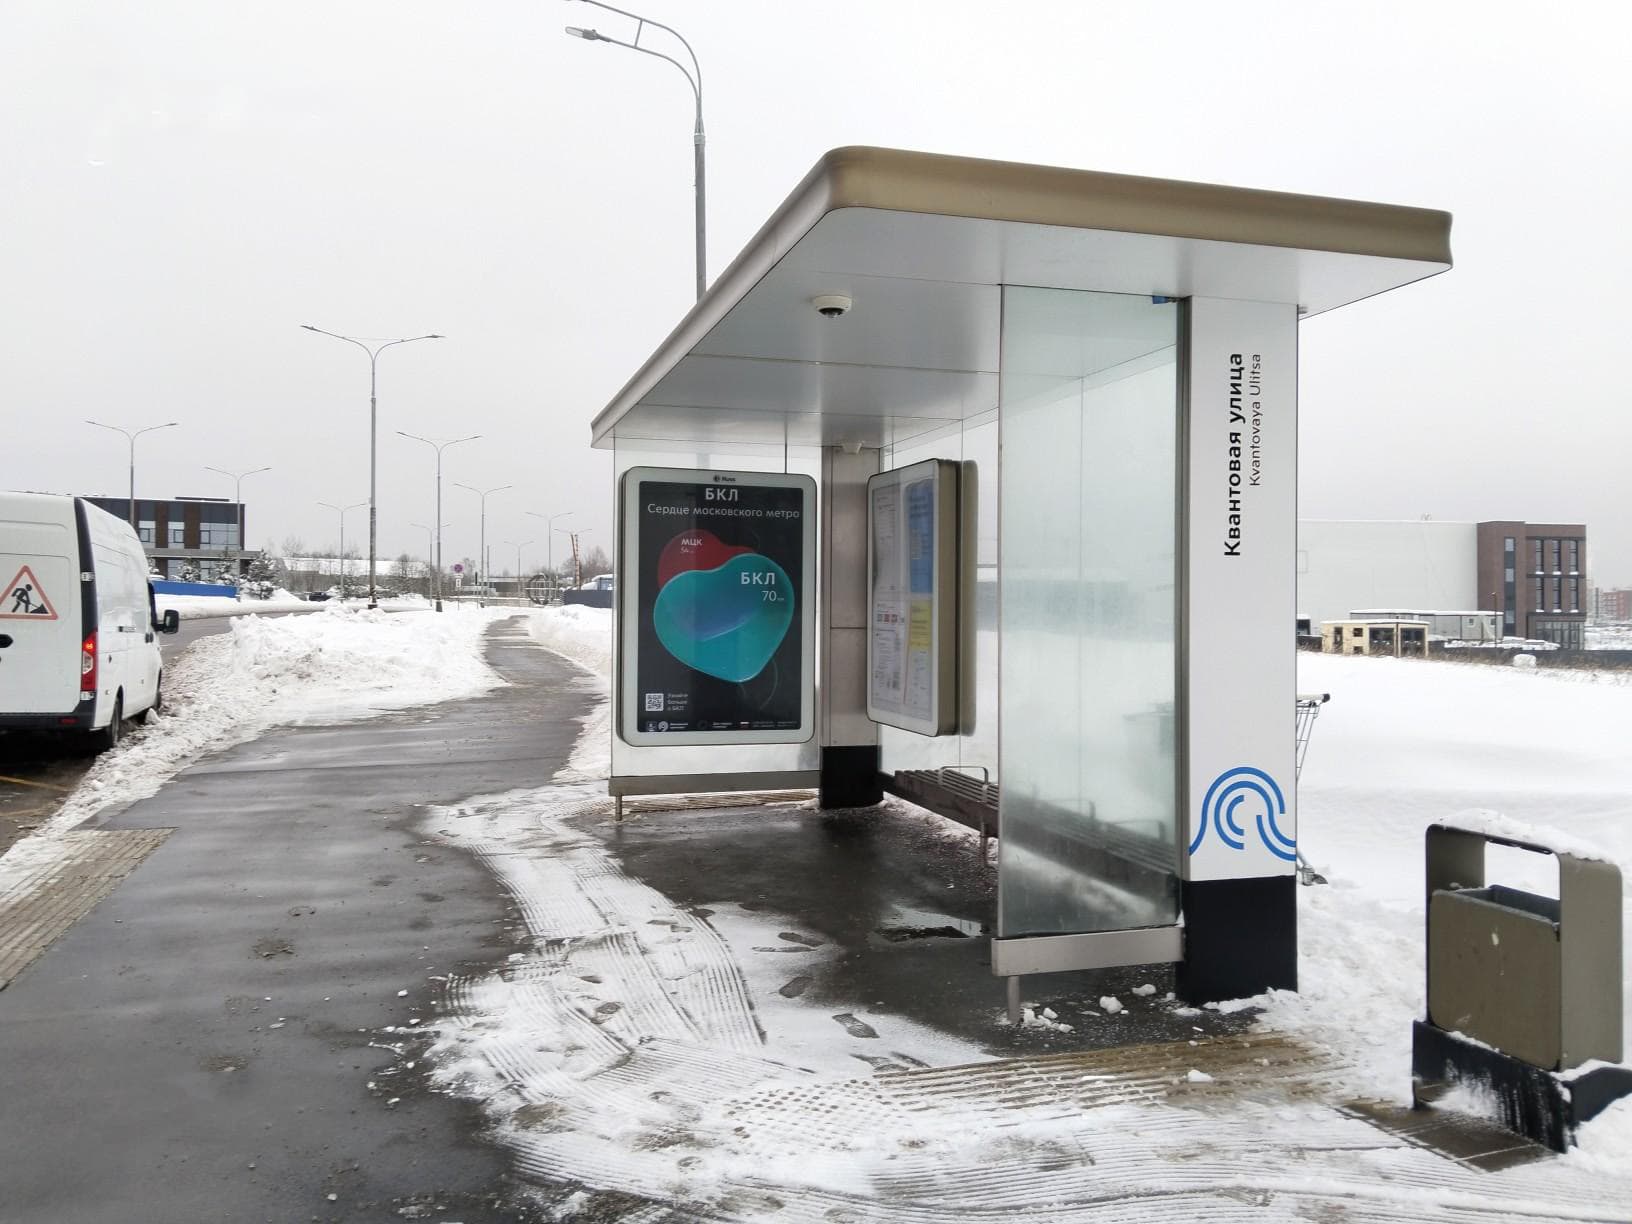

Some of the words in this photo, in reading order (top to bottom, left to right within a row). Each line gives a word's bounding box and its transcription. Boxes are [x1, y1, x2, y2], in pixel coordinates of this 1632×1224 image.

[1249, 354, 1261, 396] Ulitsa
[1229, 353, 1246, 424] улица
[1249, 401, 1263, 486] Kvantovaya
[705, 487, 739, 501] БКЛ
[1224, 432, 1241, 556] Квантовая
[647, 503, 690, 516] Сердце
[693, 507, 763, 517] московского
[766, 508, 800, 520] метро
[681, 538, 703, 547] МЦК
[741, 572, 776, 585] БКЛ
[761, 590, 777, 601] 70
